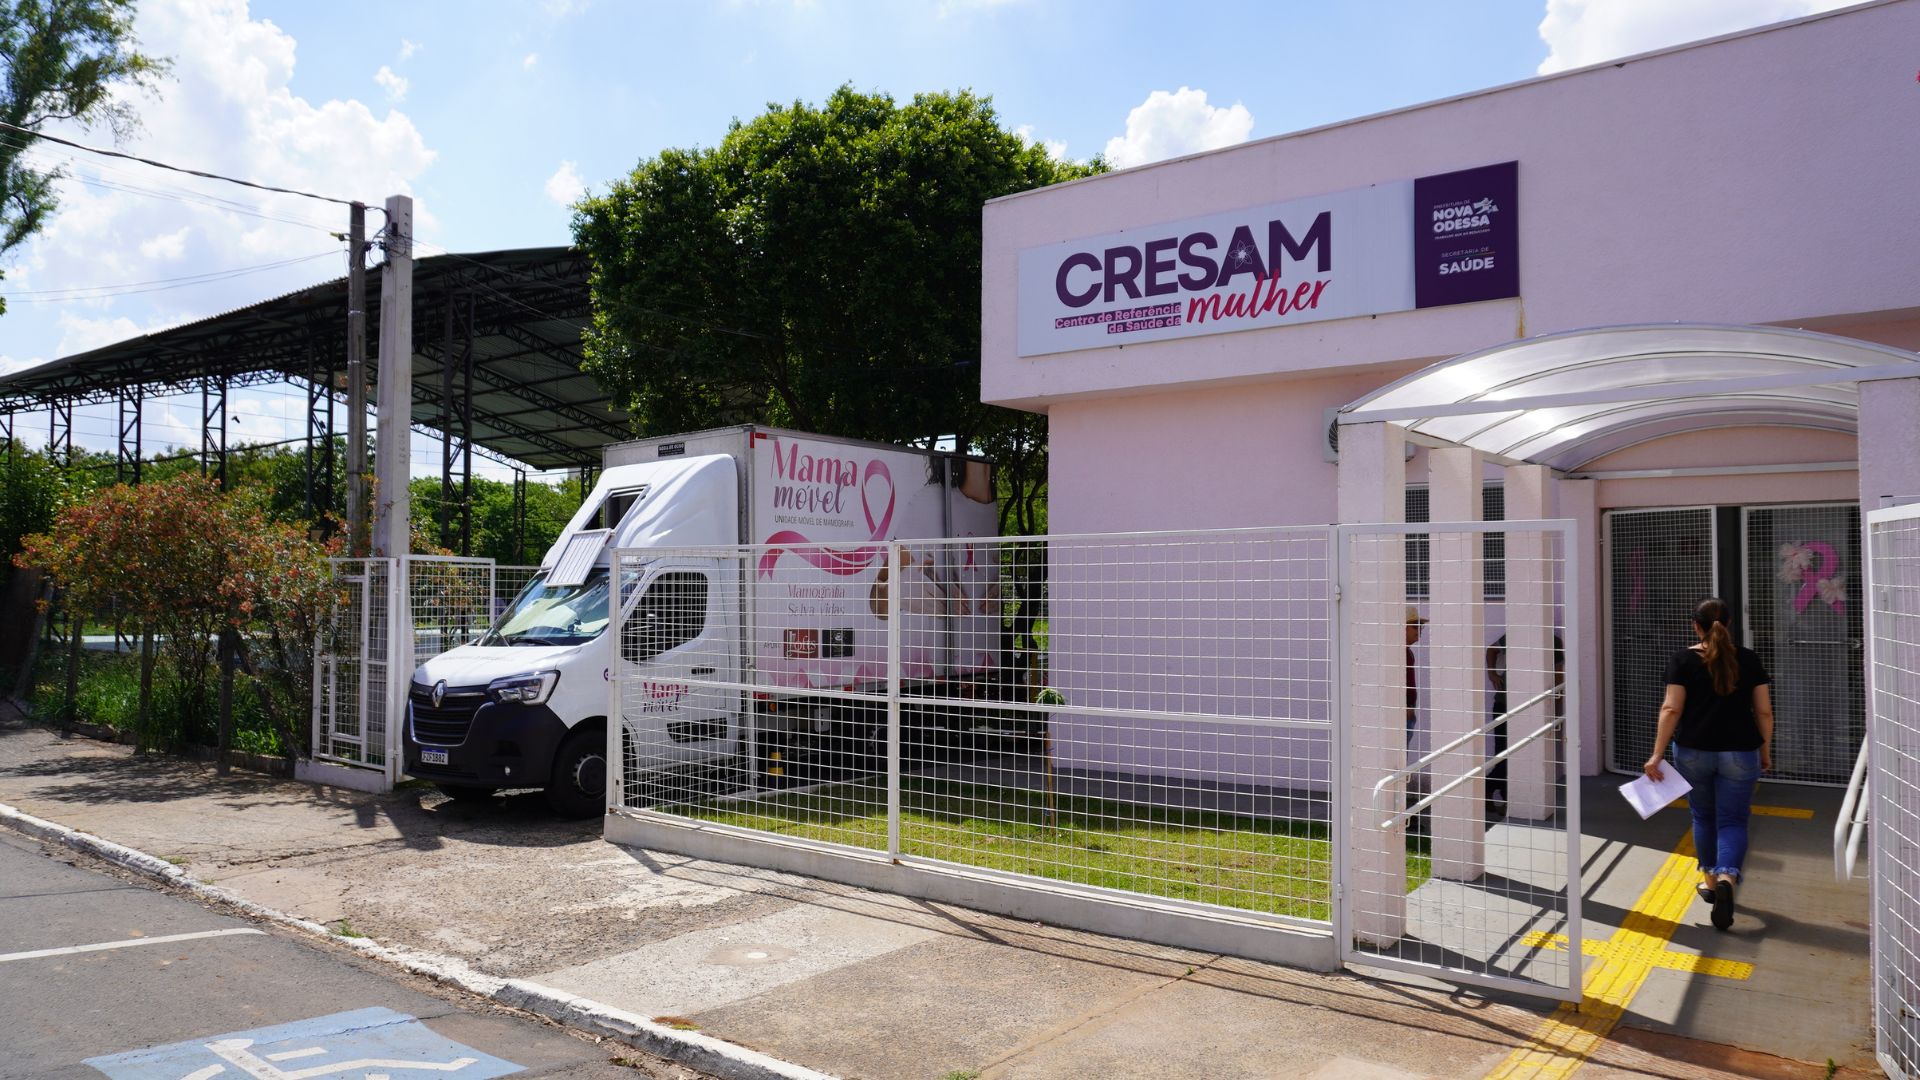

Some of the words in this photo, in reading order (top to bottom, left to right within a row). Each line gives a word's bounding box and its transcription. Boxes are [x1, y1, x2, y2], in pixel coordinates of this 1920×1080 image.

[1433, 205, 1473, 221] NOVA
[1433, 214, 1490, 233] ODESSA
[1056, 211, 1331, 308] CRESAM
[1441, 248, 1479, 258] SECRETARIA
[1439, 257, 1495, 275] SAÚDE
[1186, 268, 1331, 324] mulher
[1055, 315, 1095, 329] Centro
[1097, 312, 1113, 323] de
[1114, 303, 1181, 320] Referência
[1108, 324, 1124, 334] da
[1126, 317, 1164, 332] Saúde
[1166, 315, 1181, 326] da
[771, 440, 858, 487] Mama
[774, 472, 845, 514] móvel
[774, 514, 797, 524] UNIDADE
[815, 518, 822, 526] DE
[823, 518, 855, 528] MAMOGRAFIA
[788, 584, 845, 600] Mamografia
[788, 602, 815, 616] Salva
